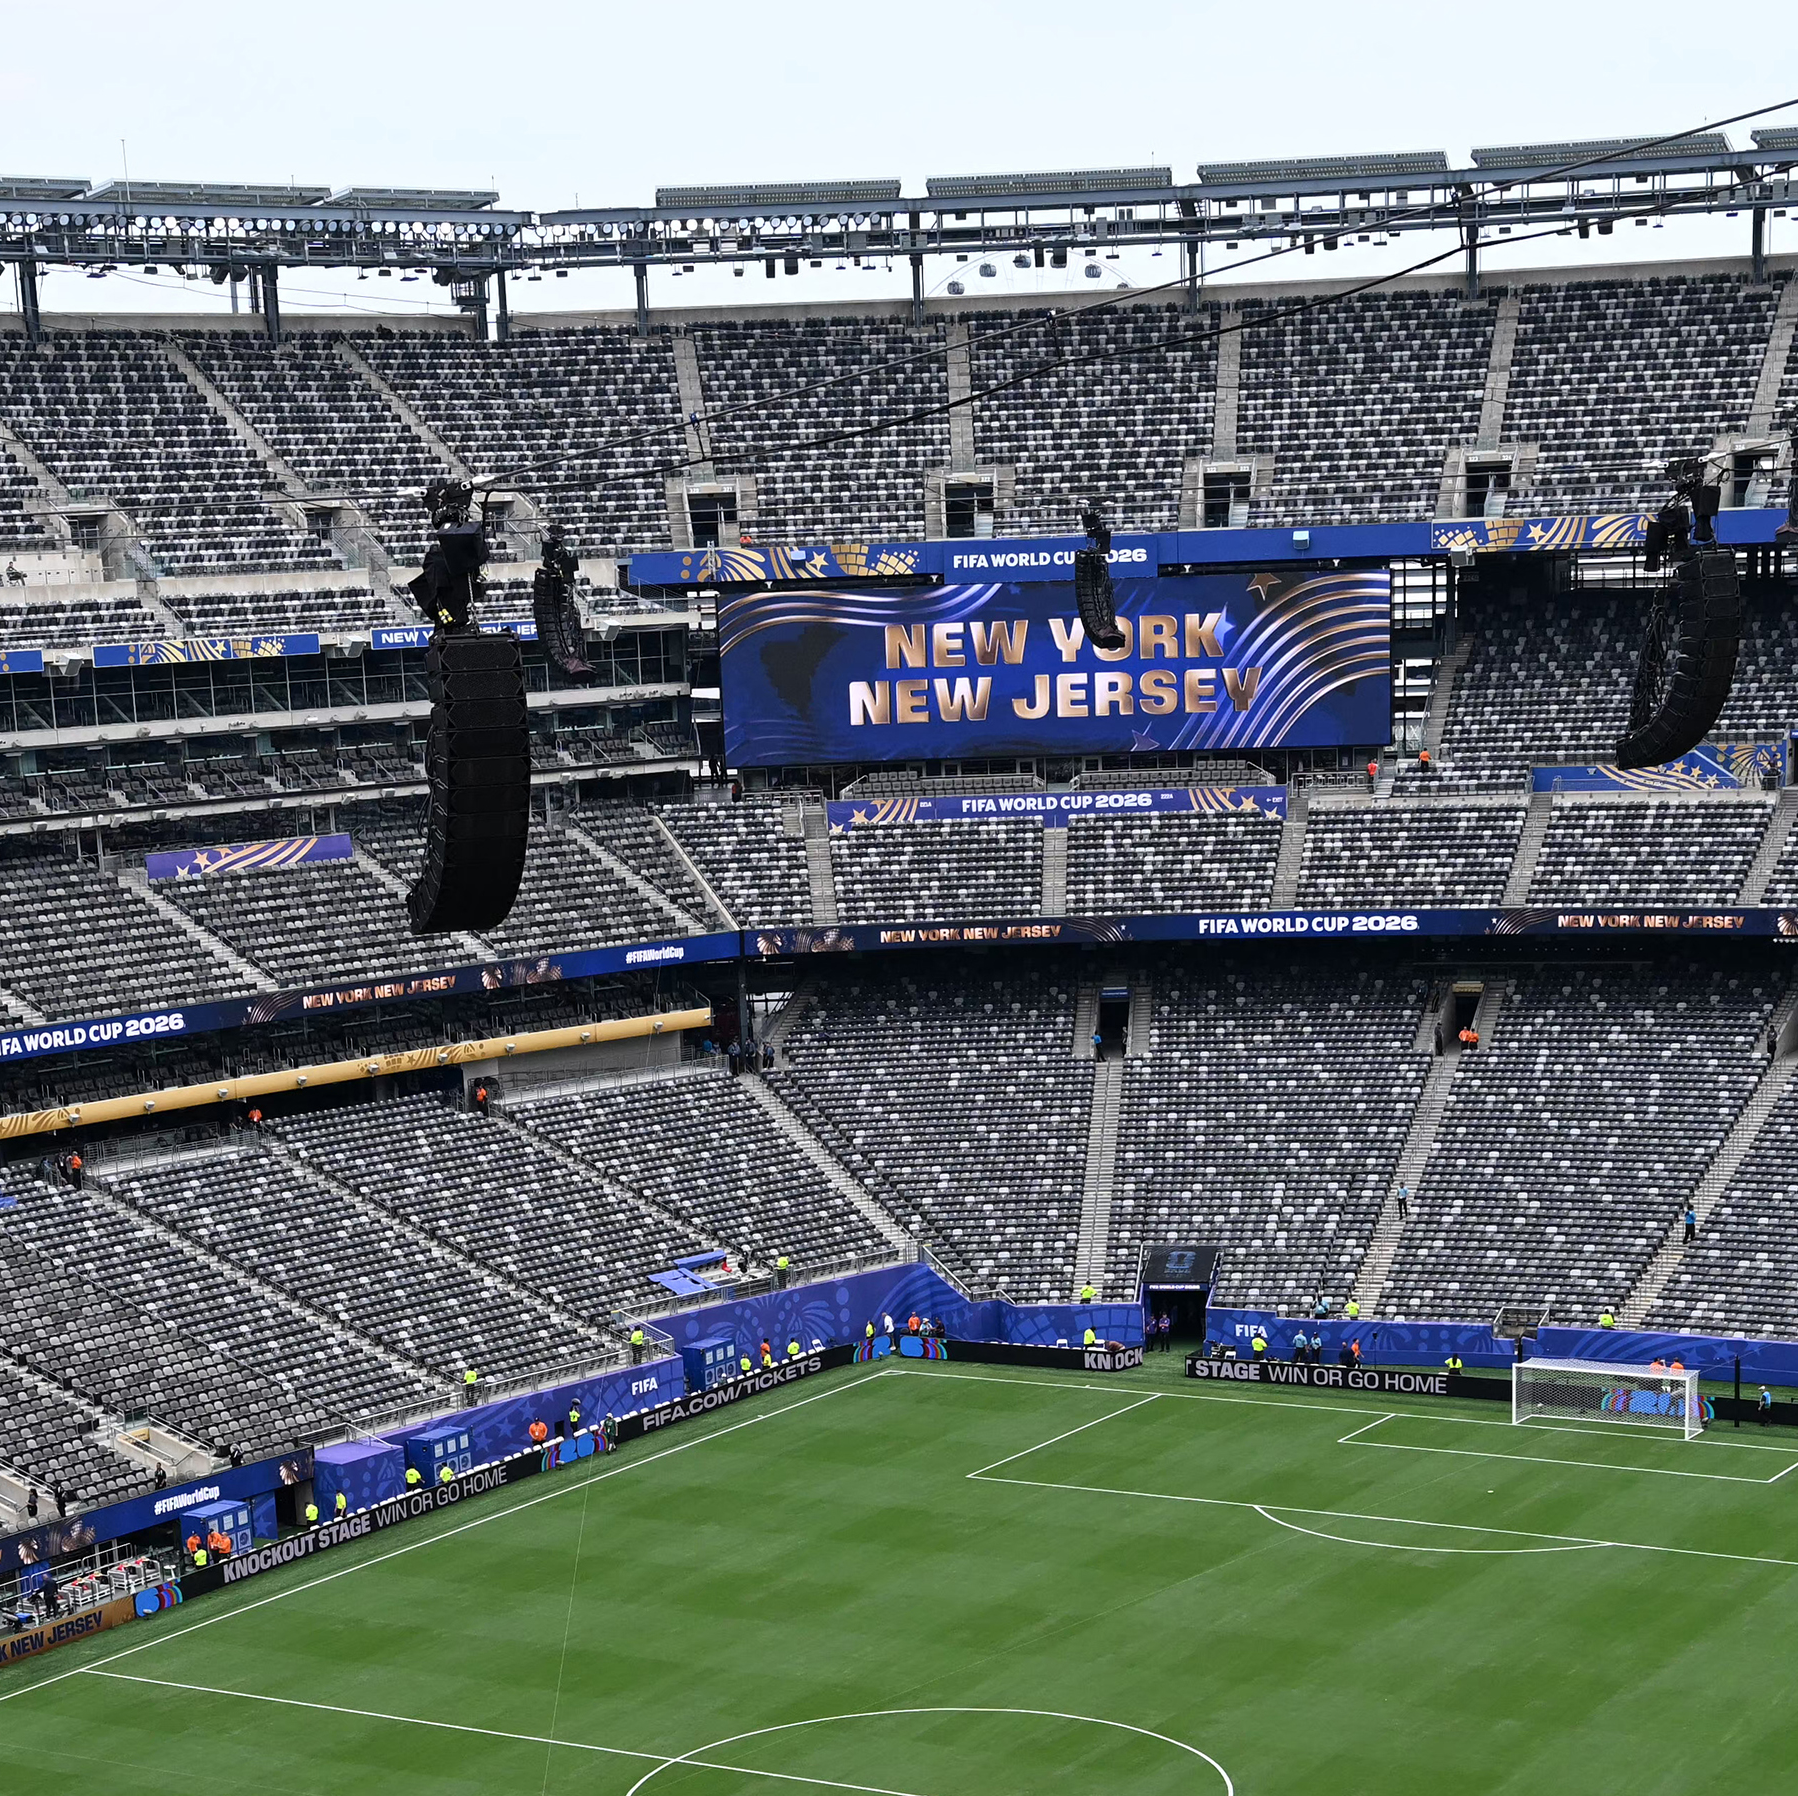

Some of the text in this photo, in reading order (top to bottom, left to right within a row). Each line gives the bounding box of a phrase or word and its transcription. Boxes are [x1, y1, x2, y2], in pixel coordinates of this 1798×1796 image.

[953, 554, 989, 569] FIFA
[992, 553, 1050, 567] WORLD
[1104, 549, 1147, 563] 026
[381, 630, 418, 645] NEW
[884, 612, 1223, 668] NEW YORK
[849, 667, 1263, 726] NEW JERSEY
[962, 794, 1152, 812] FIFA WORLD CUP 2026
[1199, 916, 1417, 933] FIFA WORLD CUP 2026
[1558, 915, 1744, 929] NEW YORK NEW JERSEY
[880, 926, 1061, 943] NEW YORK NEW JERSEY
[626, 947, 684, 963] #FIFAWorldCup
[303, 976, 455, 1009] NEW YORK NEW JERSEY
[23, 1028, 86, 1051] WORLD
[89, 1023, 123, 1041] CUP
[125, 1013, 185, 1036] 2026
[1235, 1324, 1268, 1338] FIFA
[632, 1377, 658, 1395] FIFA
[1196, 1360, 1447, 1393] STAGE WIN OR GO HOME
[643, 1358, 822, 1430] FIFA.COM/TICKETS
[155, 1486, 220, 1515] #FIFAWorldCup
[223, 1466, 508, 1583] KNOCKOUT STAGE WIN OR GO HOME
[11, 1632, 46, 1659] NEW
[47, 1611, 104, 1649] JERSEY
